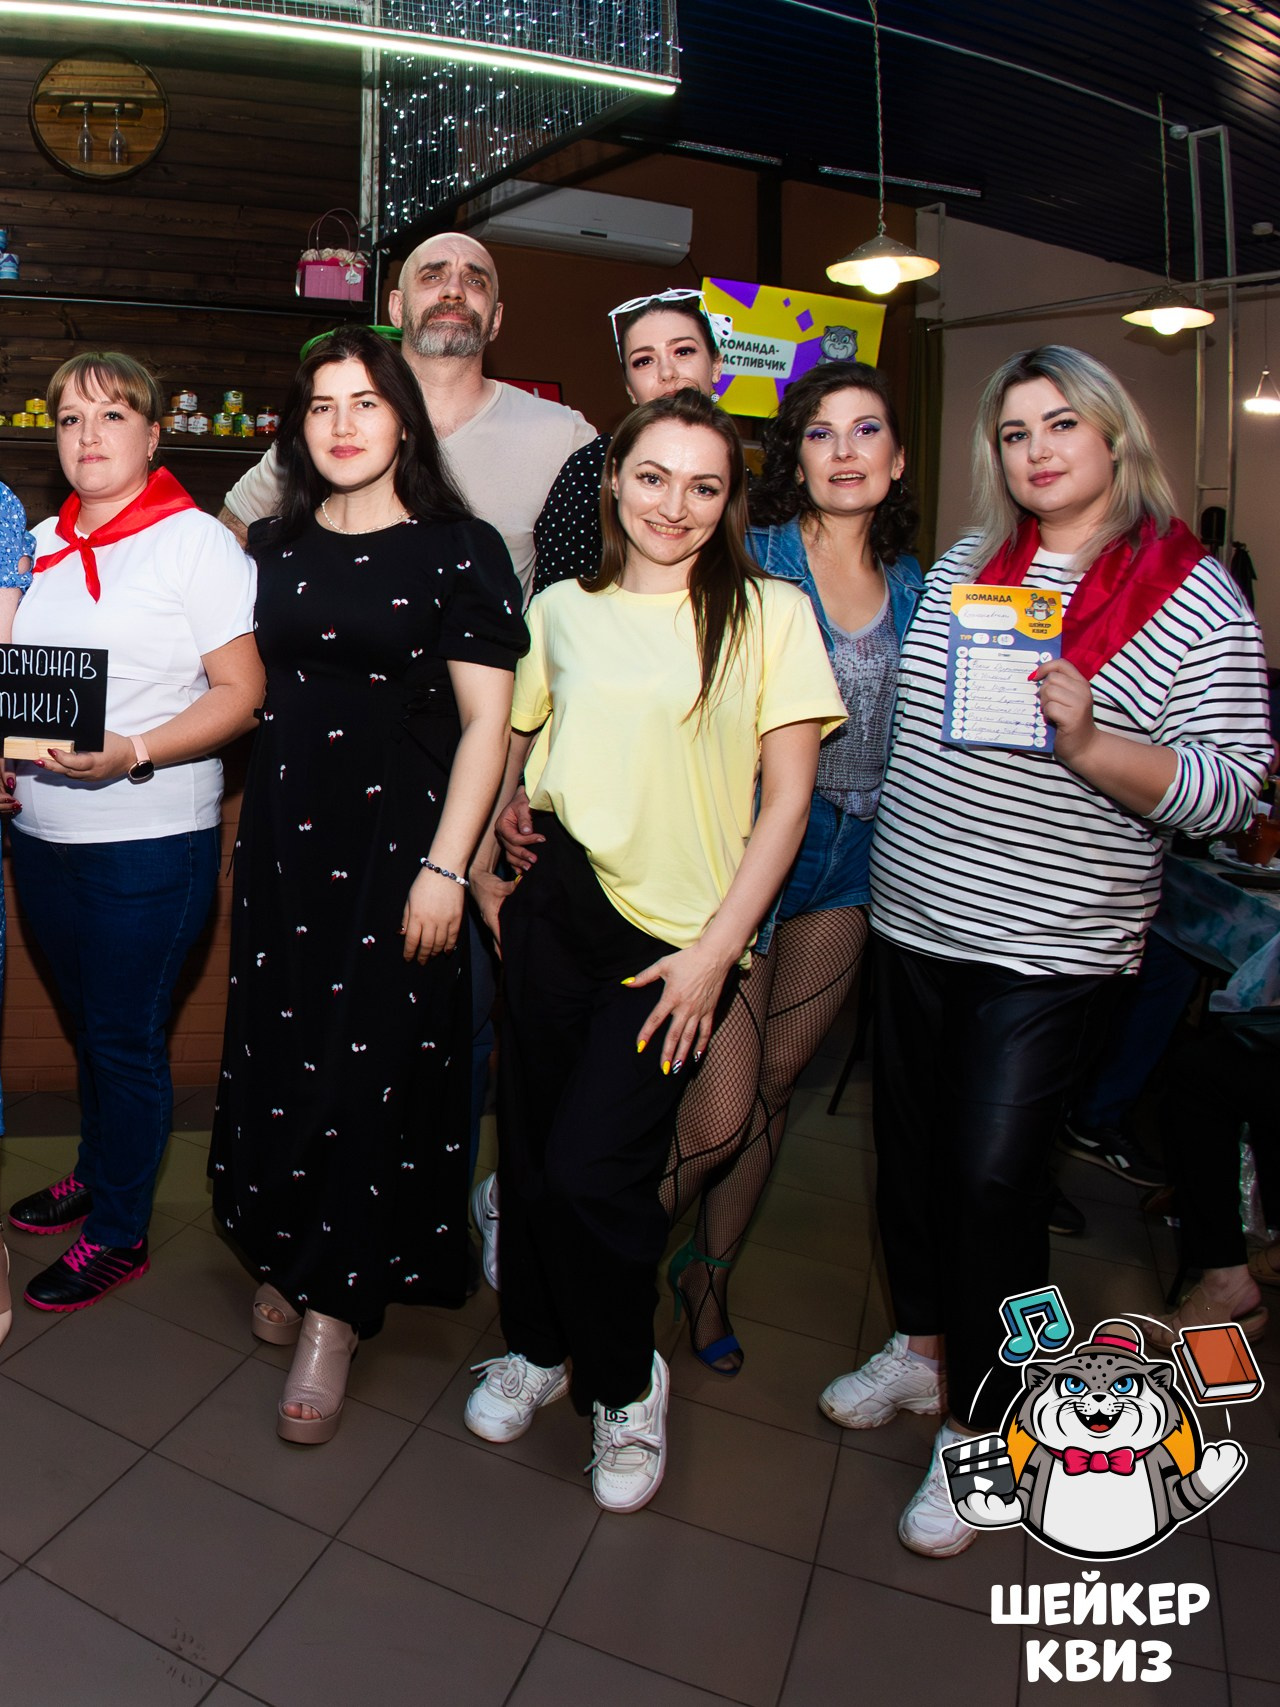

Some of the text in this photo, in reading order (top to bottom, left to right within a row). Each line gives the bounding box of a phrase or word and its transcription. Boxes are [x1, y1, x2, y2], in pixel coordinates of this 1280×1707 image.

[720, 338, 780, 355] КОМАНДА-
[722, 353, 787, 371] АСТЛИВЧИК
[965, 593, 1012, 603] КОМАНДА
